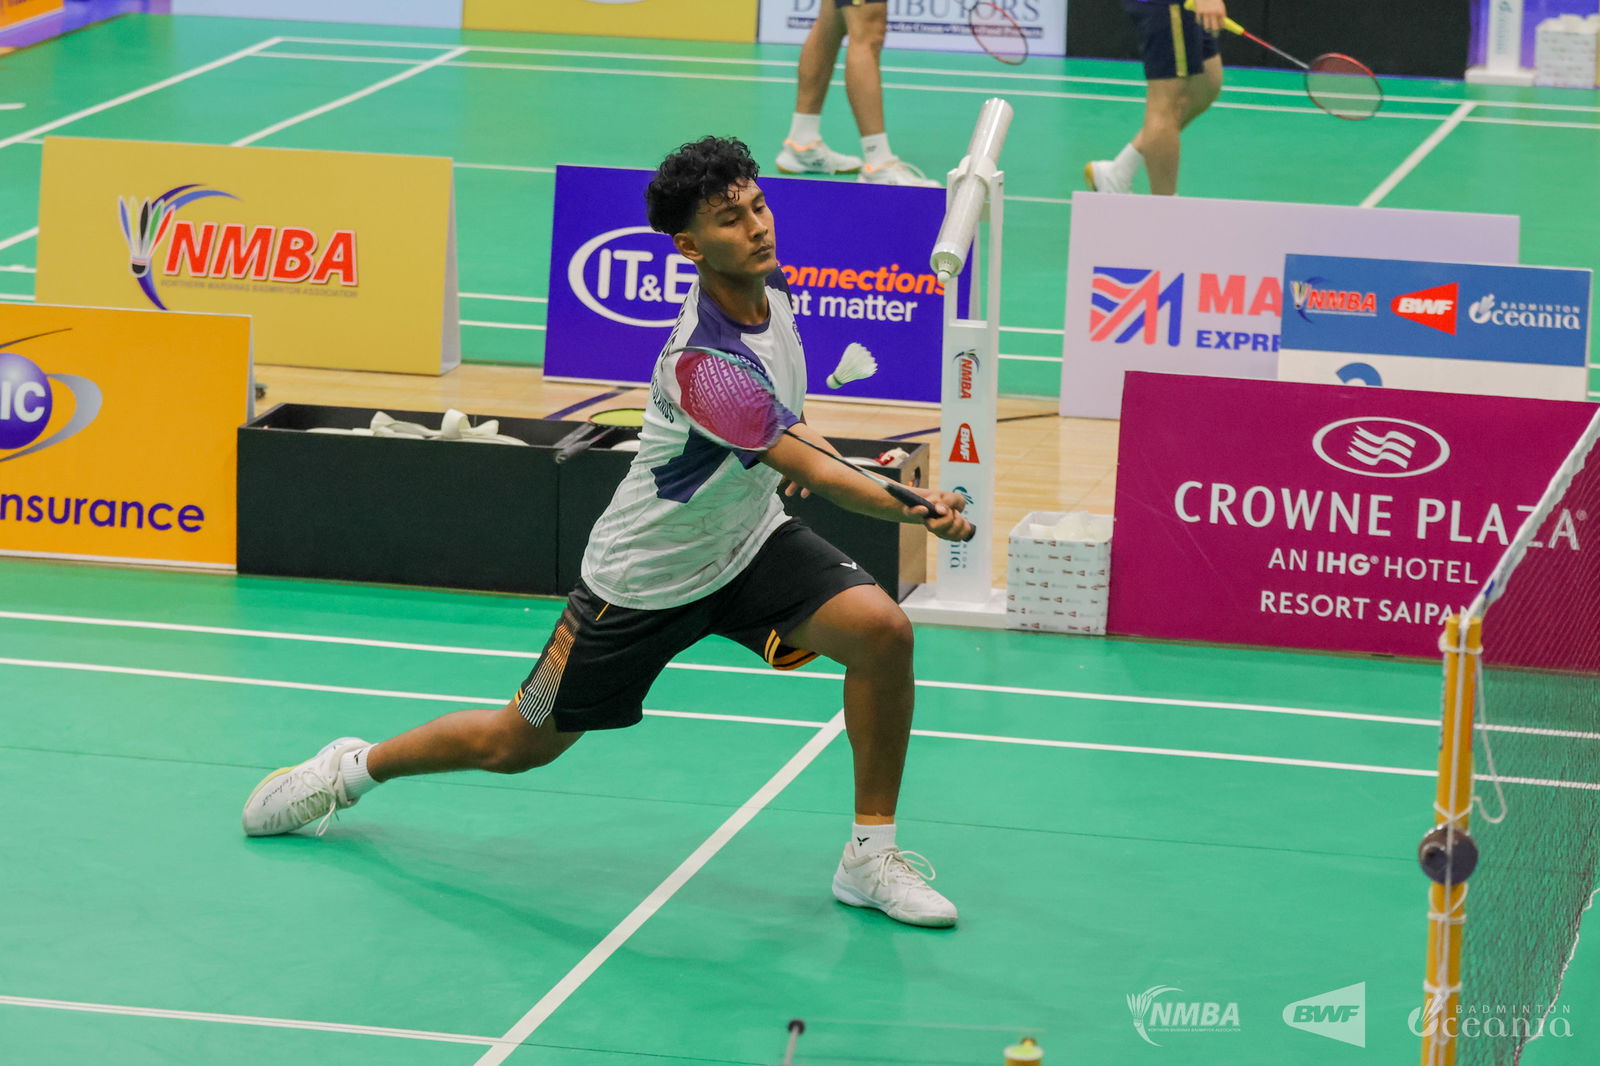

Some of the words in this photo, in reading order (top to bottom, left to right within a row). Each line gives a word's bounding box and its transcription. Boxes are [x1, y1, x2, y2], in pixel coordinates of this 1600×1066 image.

[793, 0, 1041, 22] DIBUTORS
[163, 220, 358, 286] NMBA
[597, 248, 700, 304] IT&E
[819, 294, 918, 322] matter
[1306, 289, 1377, 312] NMBA
[1398, 297, 1454, 315] BWF
[1469, 295, 1581, 330] Oceania
[1501, 302, 1580, 314] BADMINTON
[959, 358, 973, 400] NMBA
[959, 427, 971, 462] BWF
[1174, 480, 1394, 538] CROWNE
[1268, 547, 1308, 572] AN
[1384, 556, 1479, 585] HOTEL
[1260, 590, 1370, 620] RESORT
